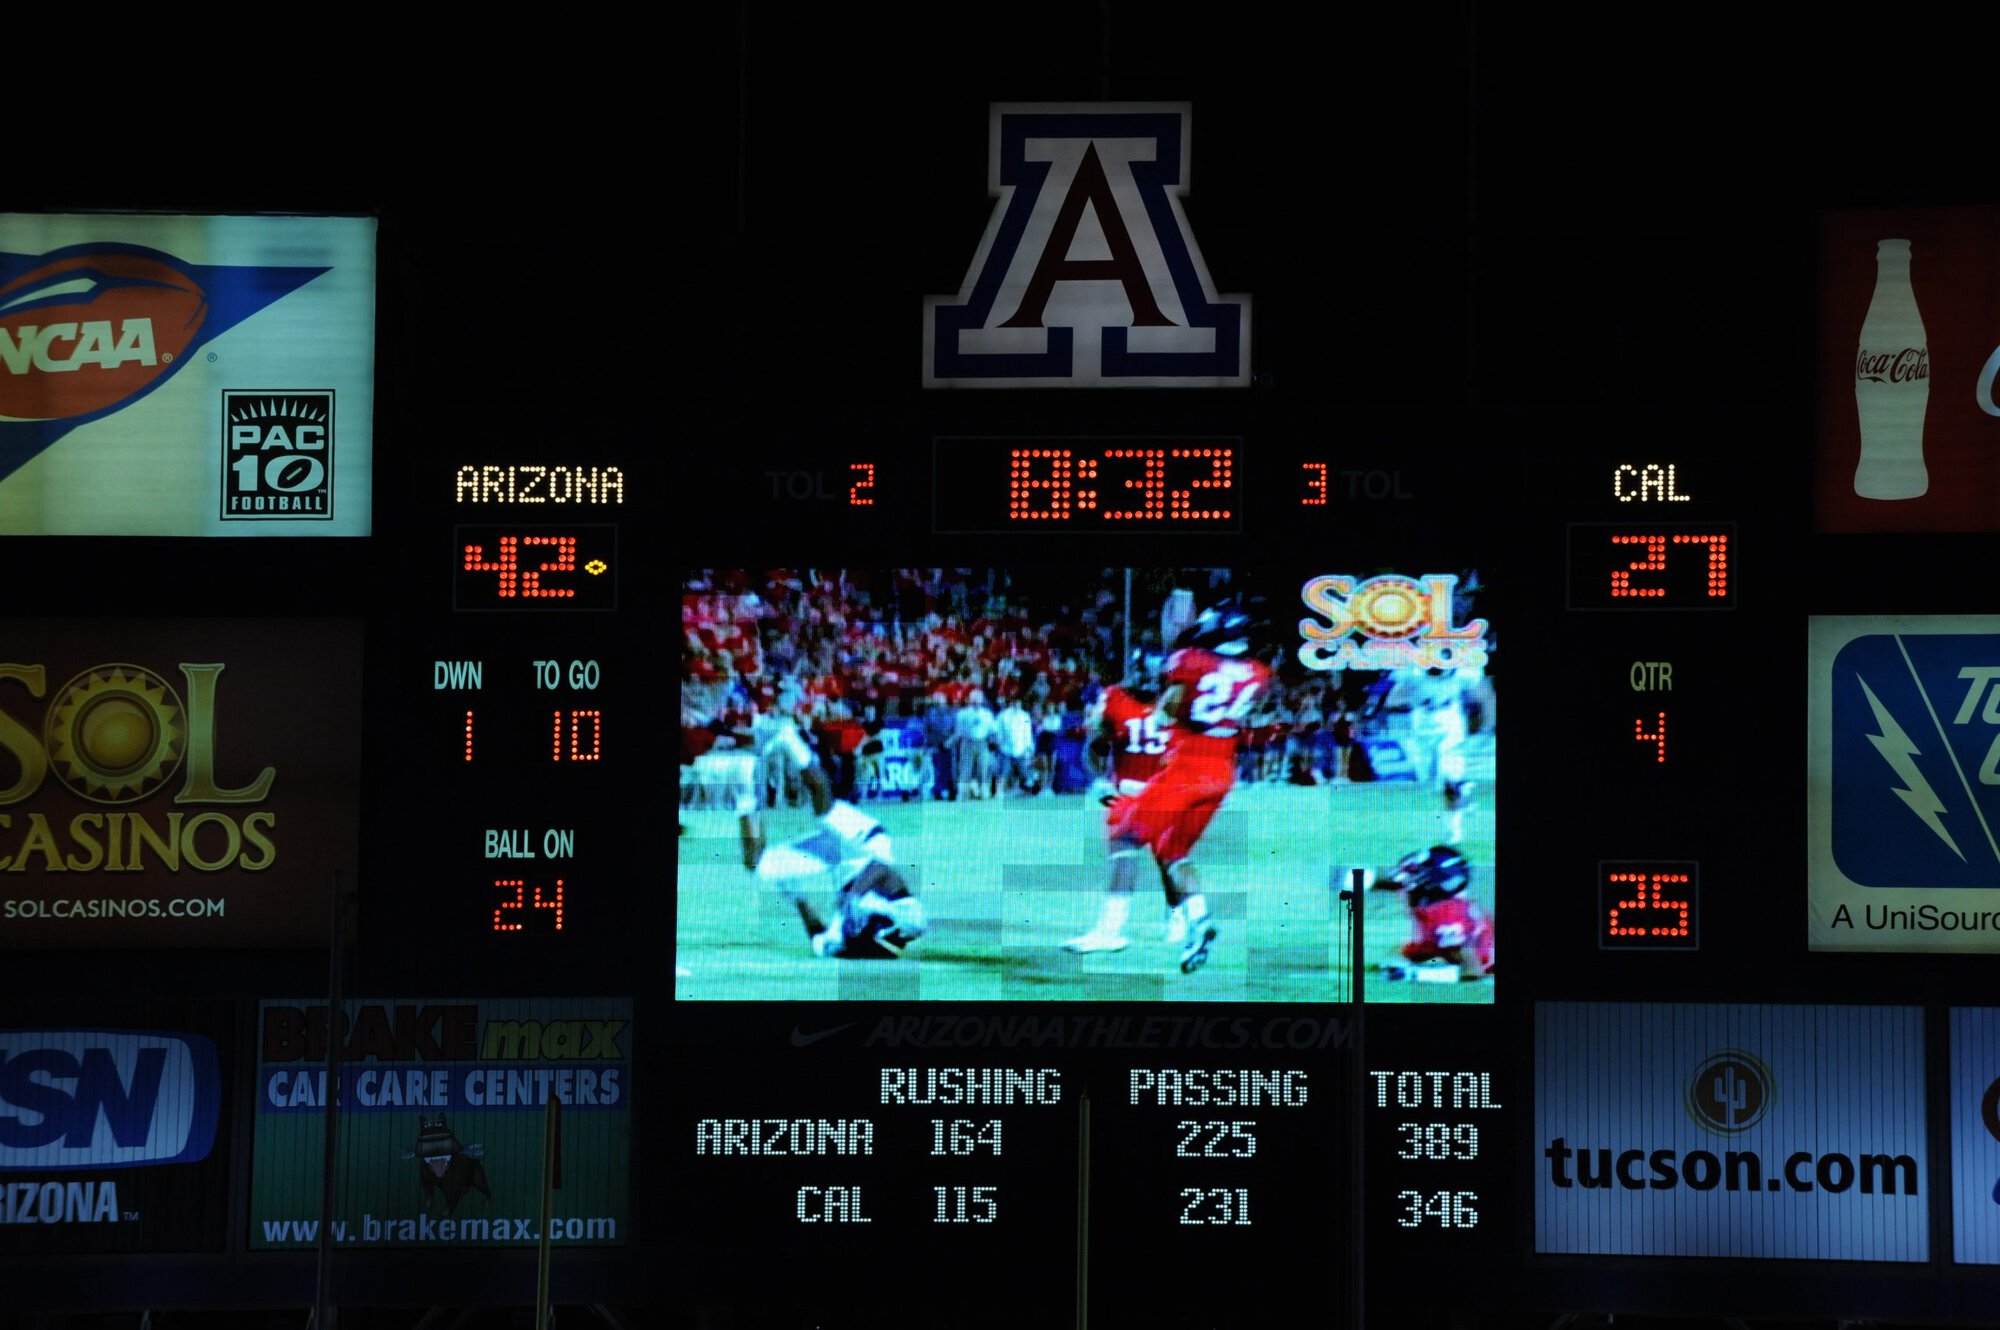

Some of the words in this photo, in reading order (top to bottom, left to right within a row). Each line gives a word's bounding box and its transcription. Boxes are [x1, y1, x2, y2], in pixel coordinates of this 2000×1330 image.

[0, 317, 158, 376] NCAA
[1857, 348, 1929, 383] Coca-Cola
[231, 425, 325, 451] PAC
[231, 454, 325, 493] 10
[455, 465, 624, 504] ARIZONA
[766, 470, 835, 500] TOL
[849, 463, 875, 506] 2
[1009, 448, 1232, 520] 8:32
[1301, 463, 1327, 505] 3
[1339, 470, 1414, 500] TOL
[1614, 463, 1691, 502] CAL
[231, 495, 323, 511] FOOTBALL
[463, 536, 577, 598] 42
[1611, 534, 1728, 598] 27
[433, 660, 483, 690] DWN
[533, 659, 561, 690] TO
[568, 659, 601, 690] GO
[1629, 661, 1673, 692] QTR
[464, 709, 474, 763] 1
[552, 709, 602, 763] 10
[1125, 718, 1172, 755] 15
[1635, 710, 1667, 764] 4
[485, 829, 536, 859] BALL
[543, 828, 575, 859] ON
[4, 898, 225, 919] SOLCASINOS.COM
[493, 878, 565, 932] 24
[1609, 873, 1689, 937] 25
[1831, 904, 1854, 929] A
[863, 1016, 1355, 1050] ARIZONAATHLETICS.COM
[0, 1048, 168, 1148] SN
[355, 1069, 449, 1107] CARE
[463, 1067, 621, 1106] CENTERS
[880, 1068, 1061, 1105] RUSHING
[1129, 1069, 1308, 1107] PASSING
[1369, 1070, 1502, 1109] TOTAL
[696, 1118, 874, 1156] ARIZONA
[930, 1119, 1002, 1156] 164
[1176, 1120, 1257, 1158] 225
[1397, 1122, 1478, 1160] 389
[1545, 1137, 1918, 1196] tucson.com
[0, 1181, 119, 1224] IZONA
[796, 1185, 872, 1223] CAL
[933, 1186, 997, 1223] 115
[1179, 1187, 1252, 1225] 231
[1397, 1190, 1478, 1228] 346
